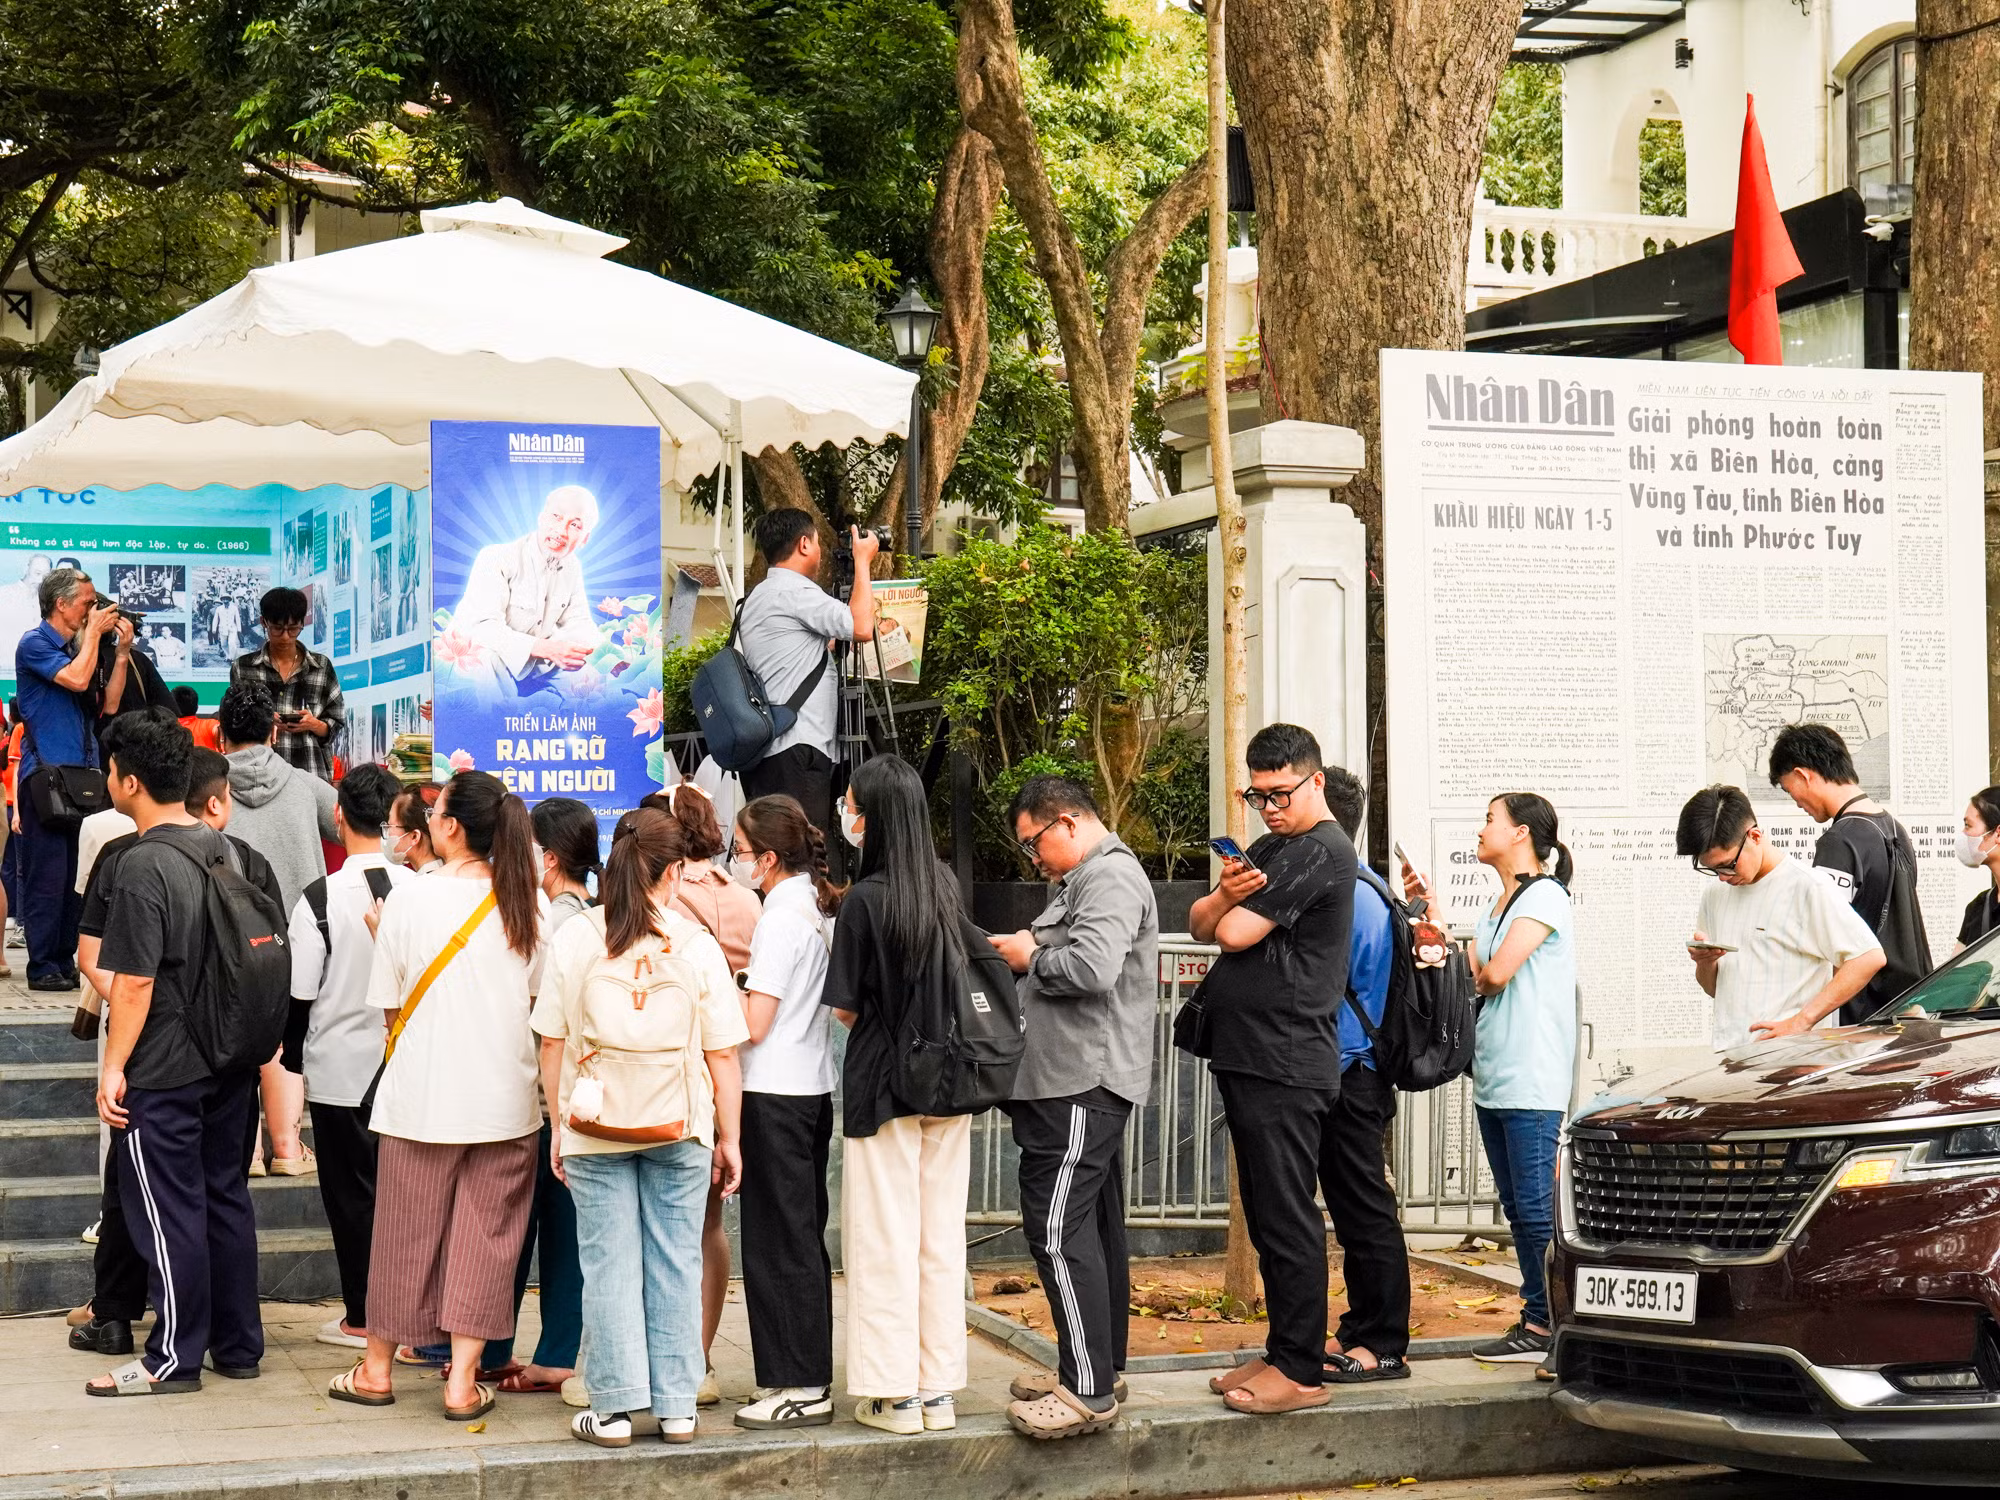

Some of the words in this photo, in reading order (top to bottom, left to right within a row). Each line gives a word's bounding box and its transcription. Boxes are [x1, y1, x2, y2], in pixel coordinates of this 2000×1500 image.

[1426, 374, 1529, 423] Nhân
[1538, 378, 1615, 426] Dân
[1668, 386, 1689, 396] NAM
[1777, 388, 1806, 400] CÔNG
[1628, 406, 1671, 434] Giải
[1688, 410, 1754, 440] phóng
[1769, 413, 1821, 439] hoàn
[1838, 416, 1883, 440] toàn
[509, 432, 552, 452] Nhân
[553, 434, 584, 452] Dân
[1628, 445, 1655, 474] thị
[1670, 450, 1698, 472] xã
[1711, 448, 1758, 474] Biên
[1771, 450, 1819, 480] Hòa,
[1833, 453, 1884, 482] cảng
[1630, 483, 1686, 516] Vũng
[1692, 485, 1738, 516] Tàu,
[1742, 488, 1782, 512] tỉnh
[1790, 488, 1836, 514] Biên
[1844, 489, 1884, 515] Hòa
[1434, 500, 1478, 528] KHẨU
[1487, 503, 1525, 532] HIỆU
[1535, 505, 1574, 531] NGÀY
[1584, 508, 1612, 531] 1-5
[10, 537, 40, 548] Không
[45, 538, 57, 546] có
[80, 538, 97, 549] quý
[103, 539, 120, 548] hơn
[149, 540, 170, 550] lập,
[194, 541, 210, 550] do.
[1656, 525, 1682, 547] và
[1692, 524, 1734, 548] tỉnh
[1744, 524, 1815, 550] Phước
[1825, 525, 1862, 556] Tuy
[505, 712, 539, 732] TRIỂN
[544, 714, 568, 732] LÃM
[571, 712, 596, 732] ẢNH
[496, 739, 566, 764] RẠNG
[572, 735, 606, 761] RỠ
[542, 766, 615, 792] NGƯỜI
[1450, 850, 1480, 865] Giả
[1179, 963, 1208, 975] STO
